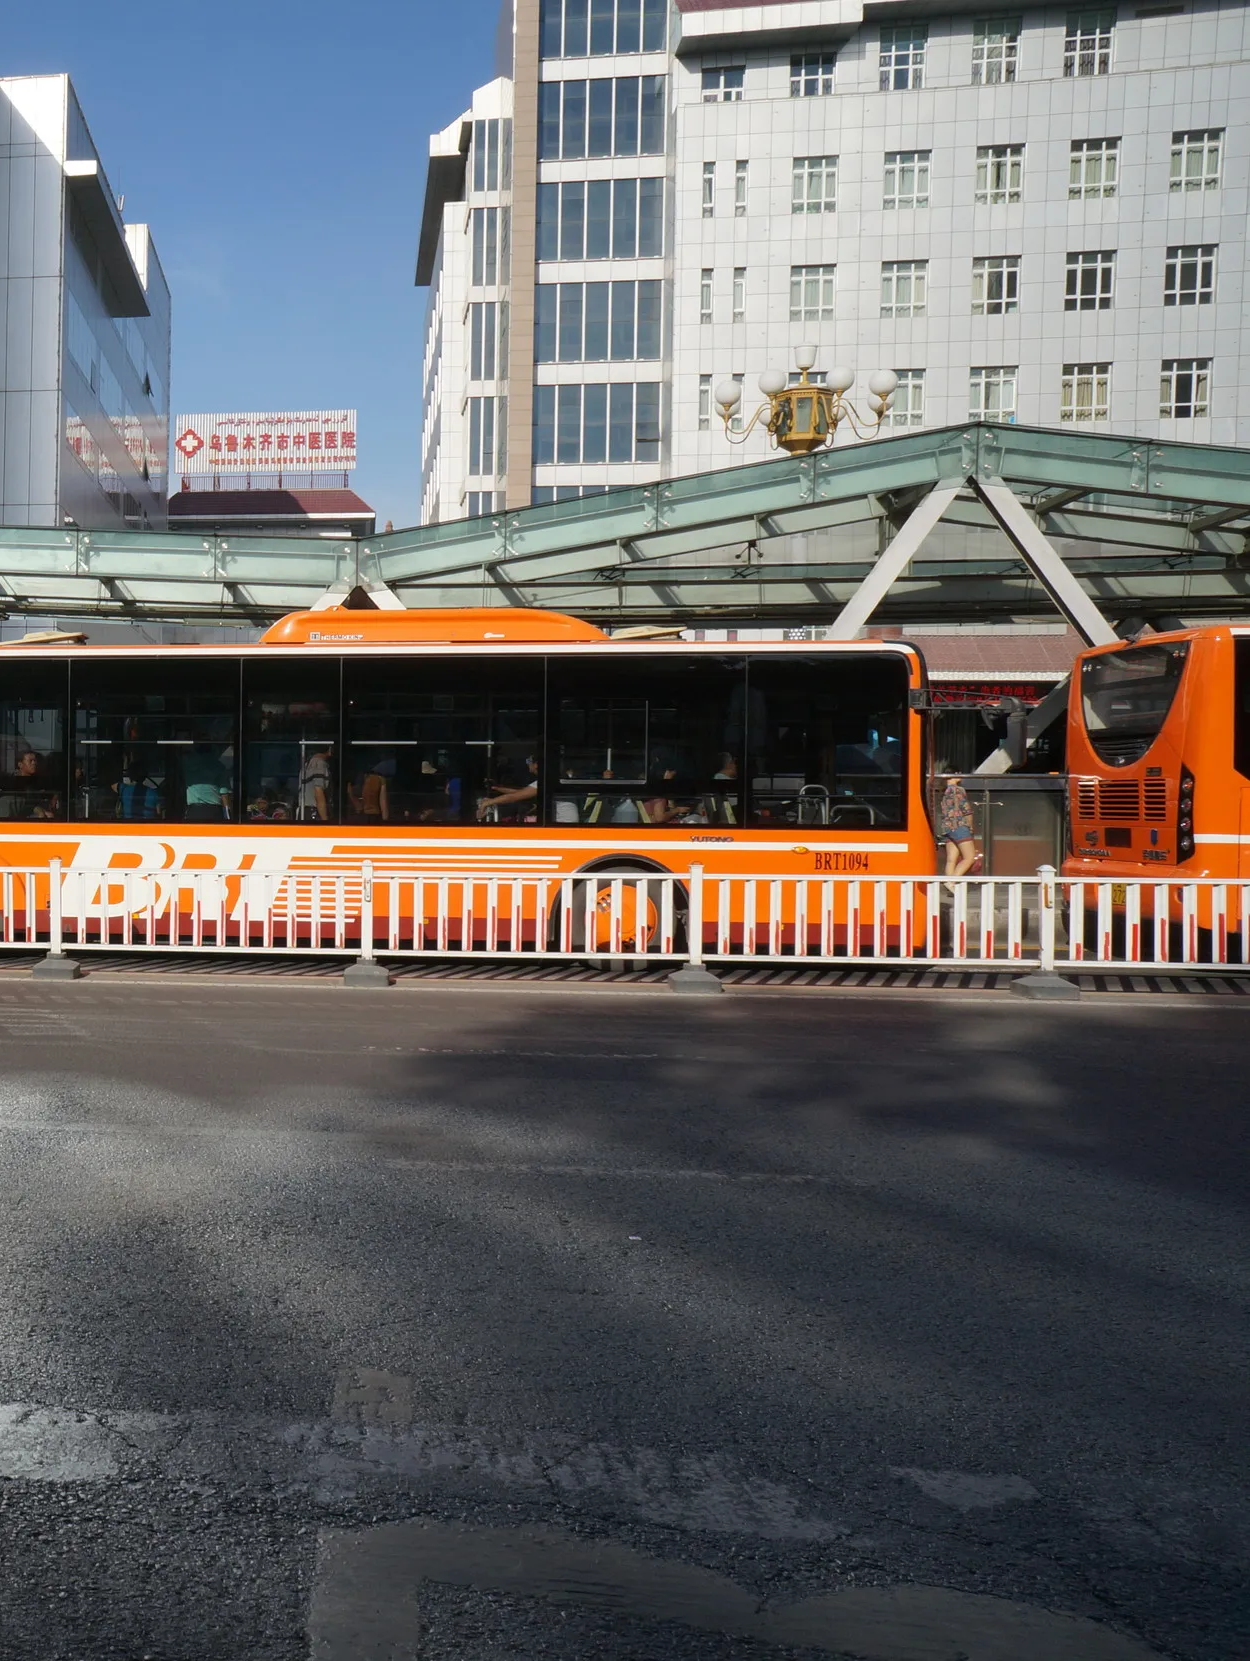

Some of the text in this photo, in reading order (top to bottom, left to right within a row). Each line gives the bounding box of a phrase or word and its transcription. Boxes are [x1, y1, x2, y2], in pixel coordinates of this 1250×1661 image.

[209, 431, 356, 452] 乌鲁木齐市中医医院
[690, 835, 734, 843] YUTONG
[815, 852, 869, 870] BRT1094
